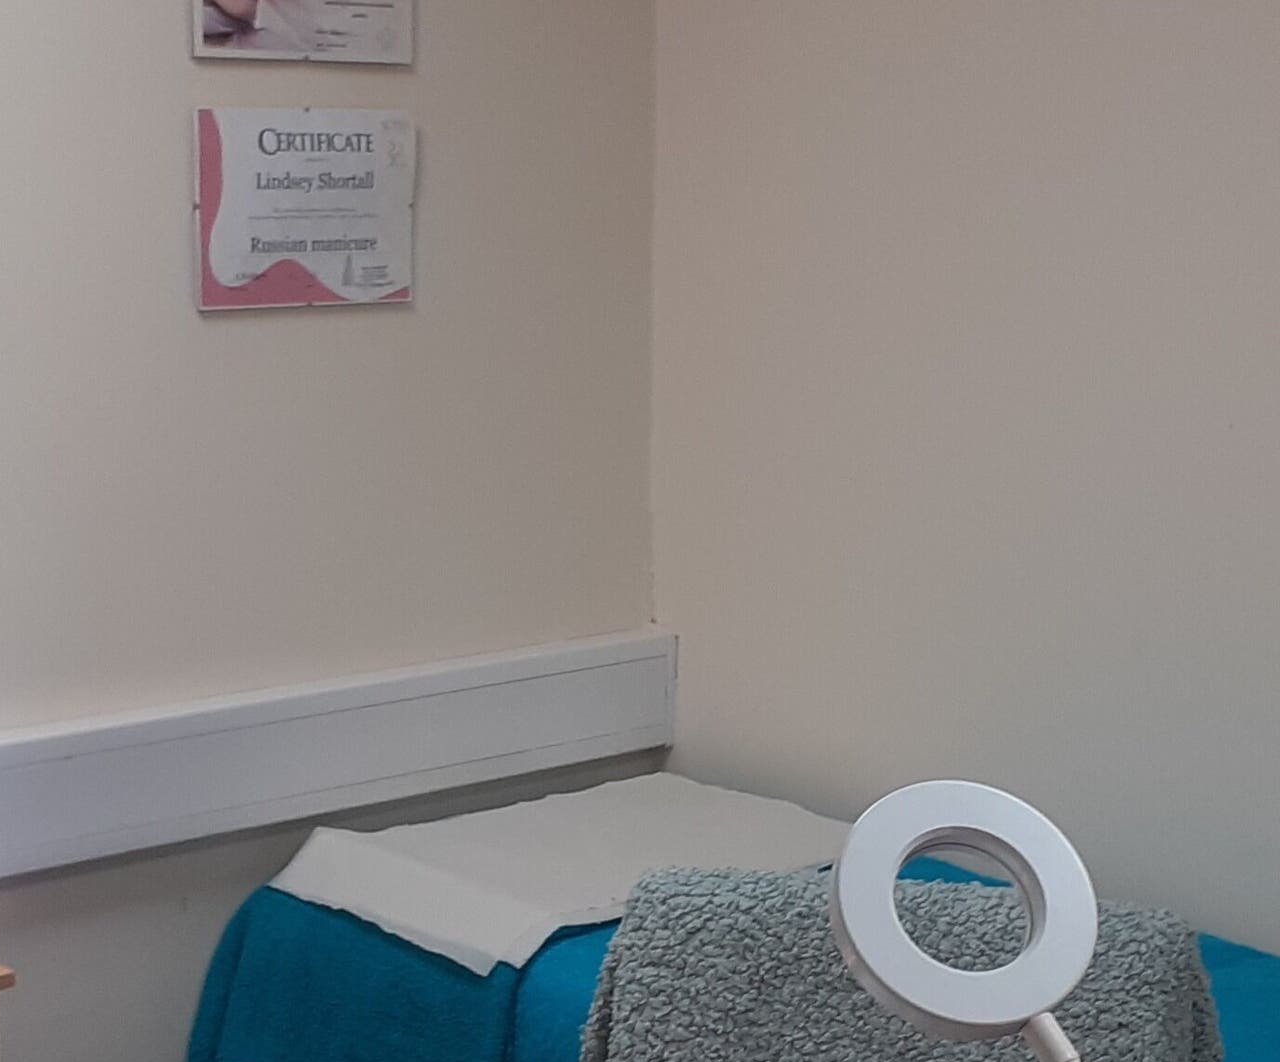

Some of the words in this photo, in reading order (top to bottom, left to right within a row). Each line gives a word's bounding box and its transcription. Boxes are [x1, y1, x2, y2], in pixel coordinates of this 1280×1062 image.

[256, 171, 315, 193] Lindsey
[319, 171, 375, 189] Shortall
[250, 235, 307, 253] Russian
[311, 232, 377, 251] manicure
